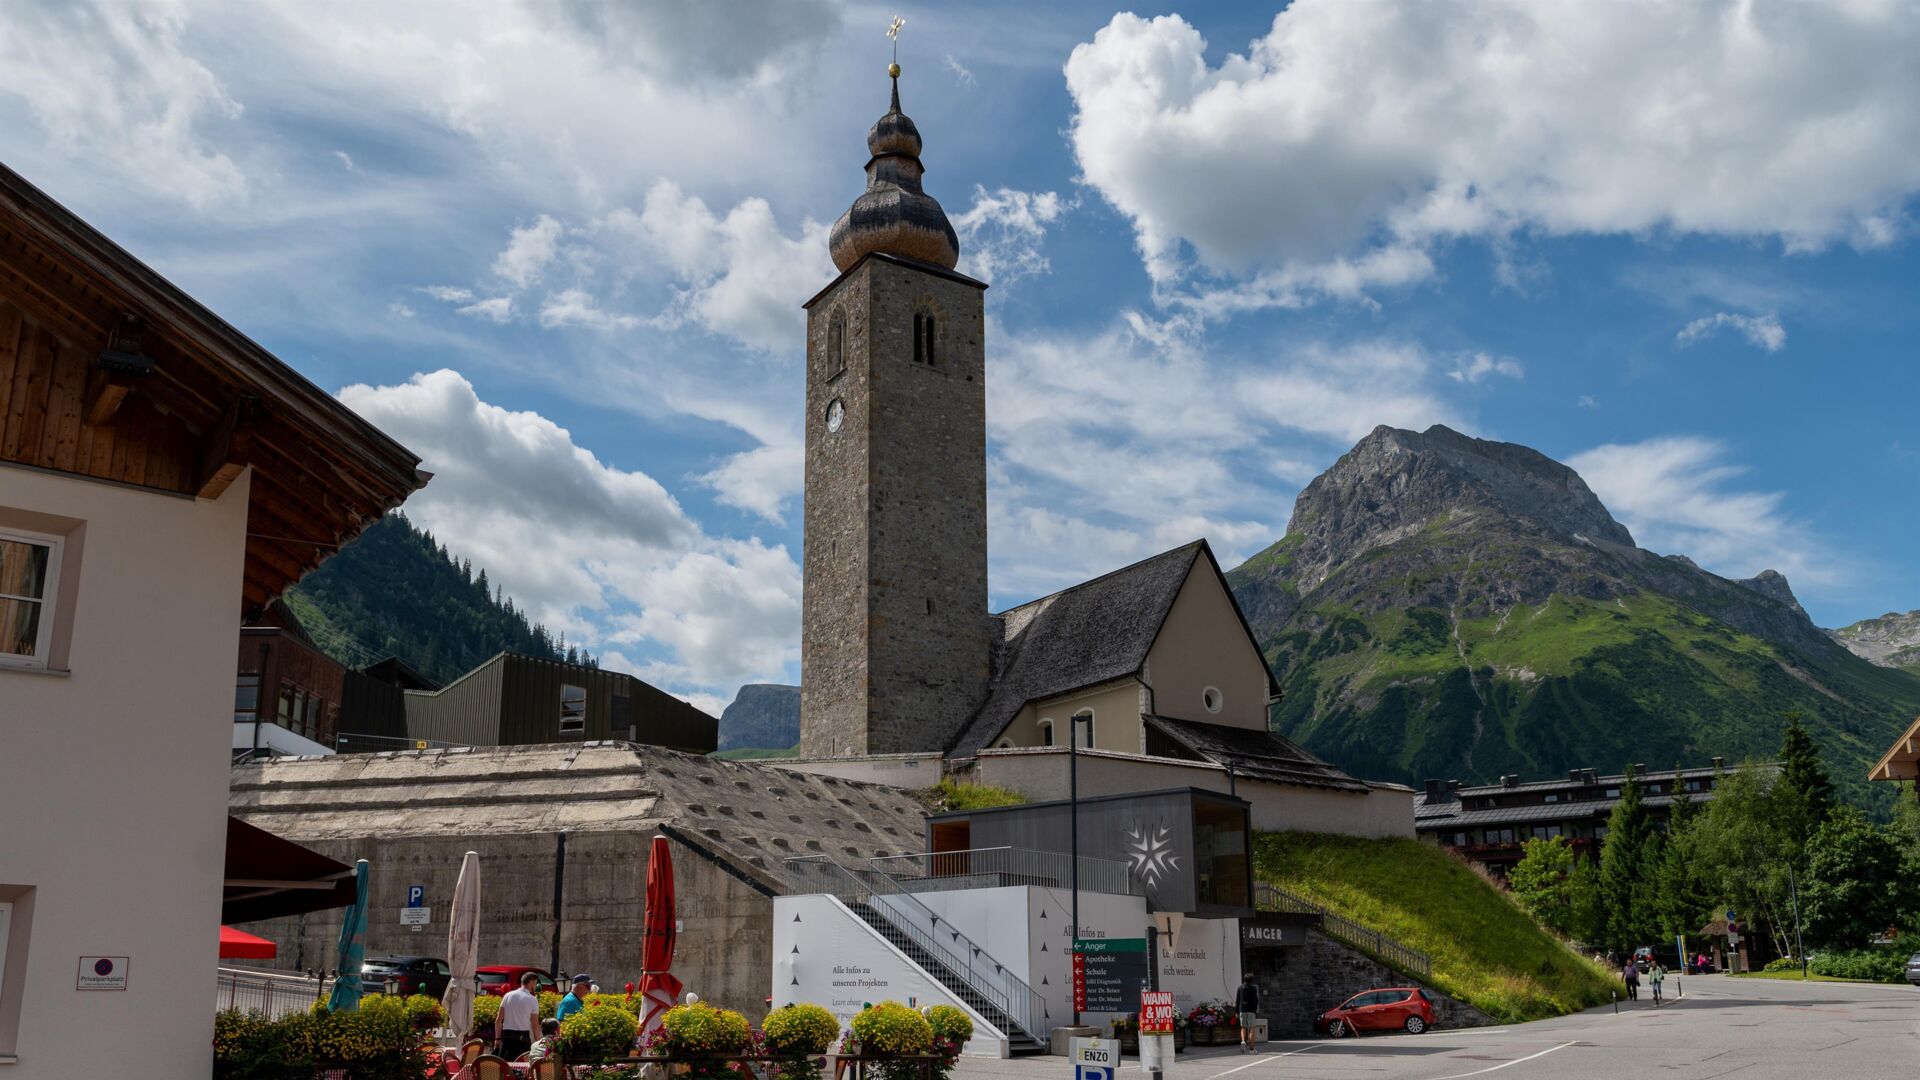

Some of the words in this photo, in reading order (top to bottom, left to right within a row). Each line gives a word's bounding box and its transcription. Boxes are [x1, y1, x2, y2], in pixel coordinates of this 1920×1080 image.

[411, 887, 422, 903] P
[1063, 925, 1073, 937] All
[1079, 926, 1096, 938] Infos
[1096, 930, 1105, 938] zu
[1249, 927, 1282, 940] ANGER
[1084, 942, 1106, 951] Anger
[1085, 955, 1116, 964] Apotheke
[1176, 948, 1206, 960] entwickelt
[832, 965, 845, 974] Alle
[845, 965, 862, 974] Infos
[1085, 968, 1107, 976] Schule
[1163, 965, 1175, 976] sich
[1175, 965, 1196, 977] weiter.
[857, 978, 889, 989] Projekten
[832, 998, 847, 1006] Learn
[846, 996, 862, 1006] about
[1142, 992, 1172, 1006] WANN
[1146, 1005, 1154, 1019] &
[1155, 1005, 1172, 1019] WO
[1084, 1050, 1109, 1062] ENZO
